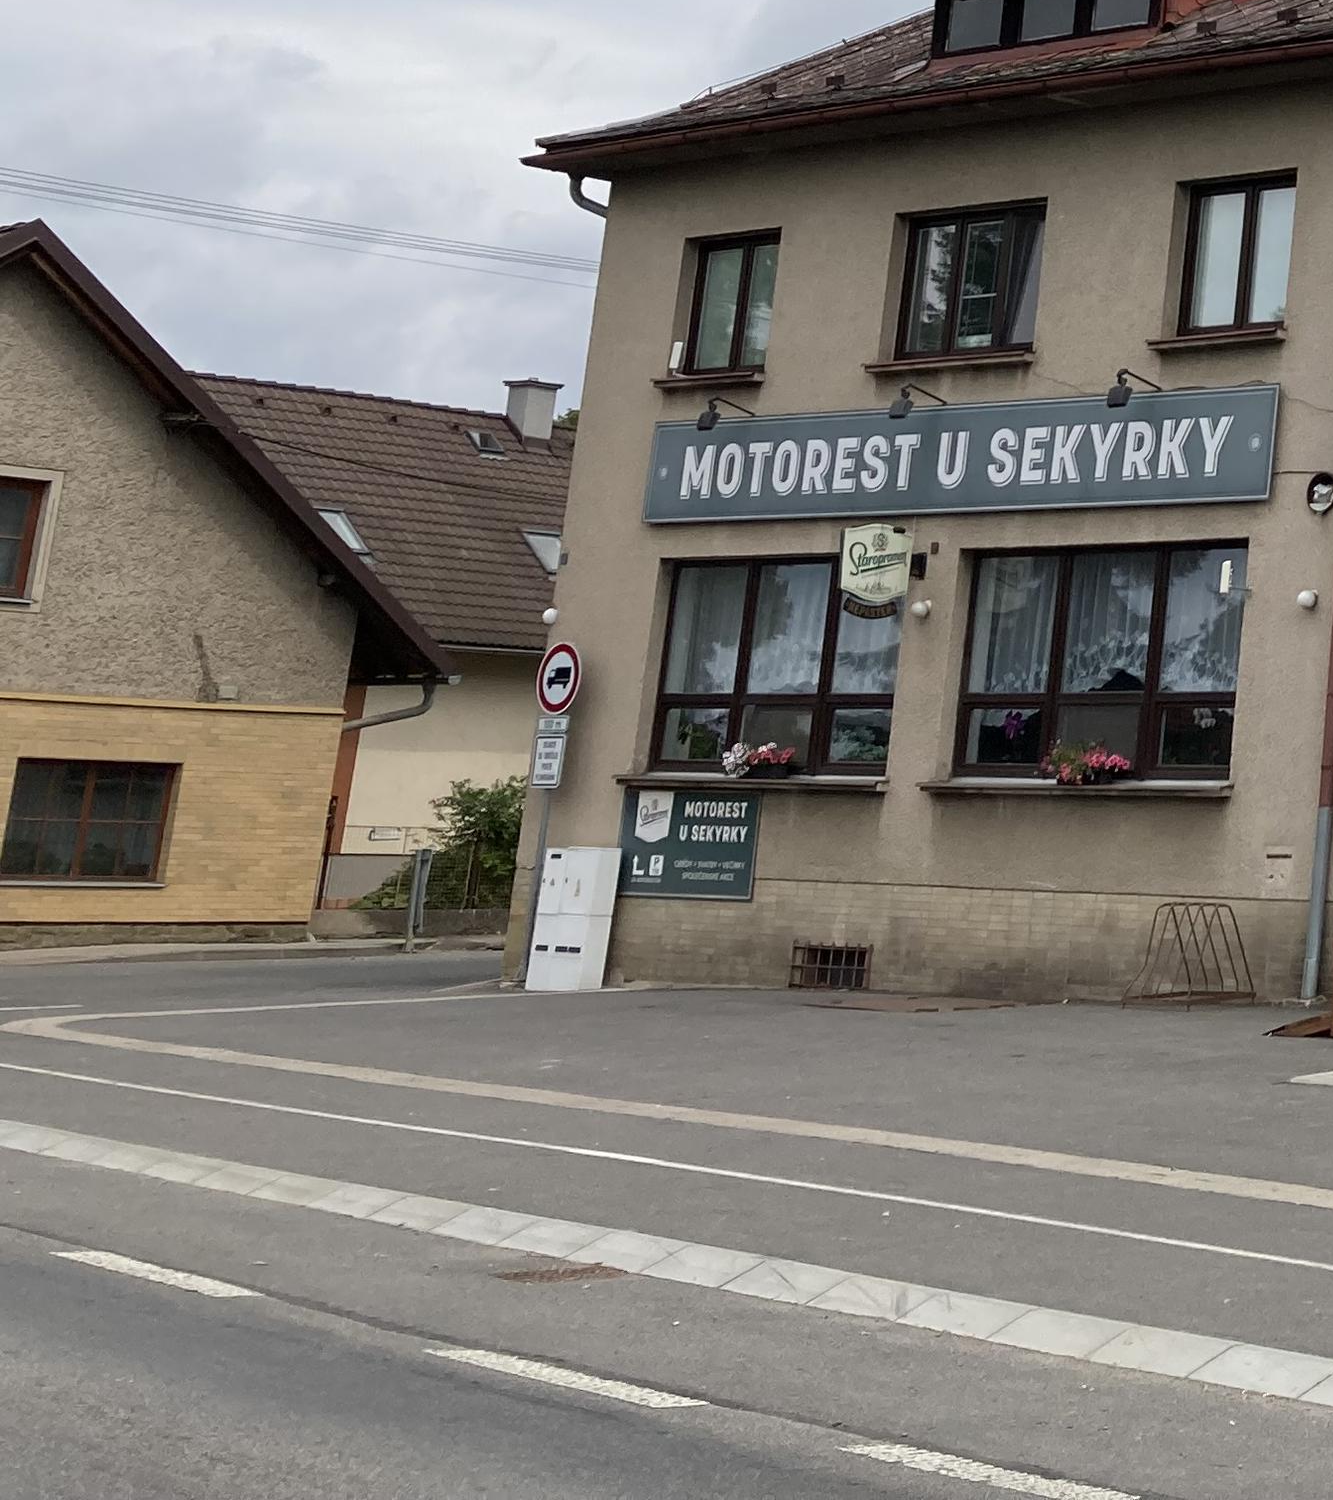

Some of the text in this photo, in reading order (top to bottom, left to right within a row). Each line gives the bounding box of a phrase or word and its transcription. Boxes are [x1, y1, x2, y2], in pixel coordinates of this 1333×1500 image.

[680, 415, 1235, 500] MOTOREST U SEKYRKY
[684, 801, 748, 819] MOTOREST
[679, 824, 748, 843] U SEKYRKY
